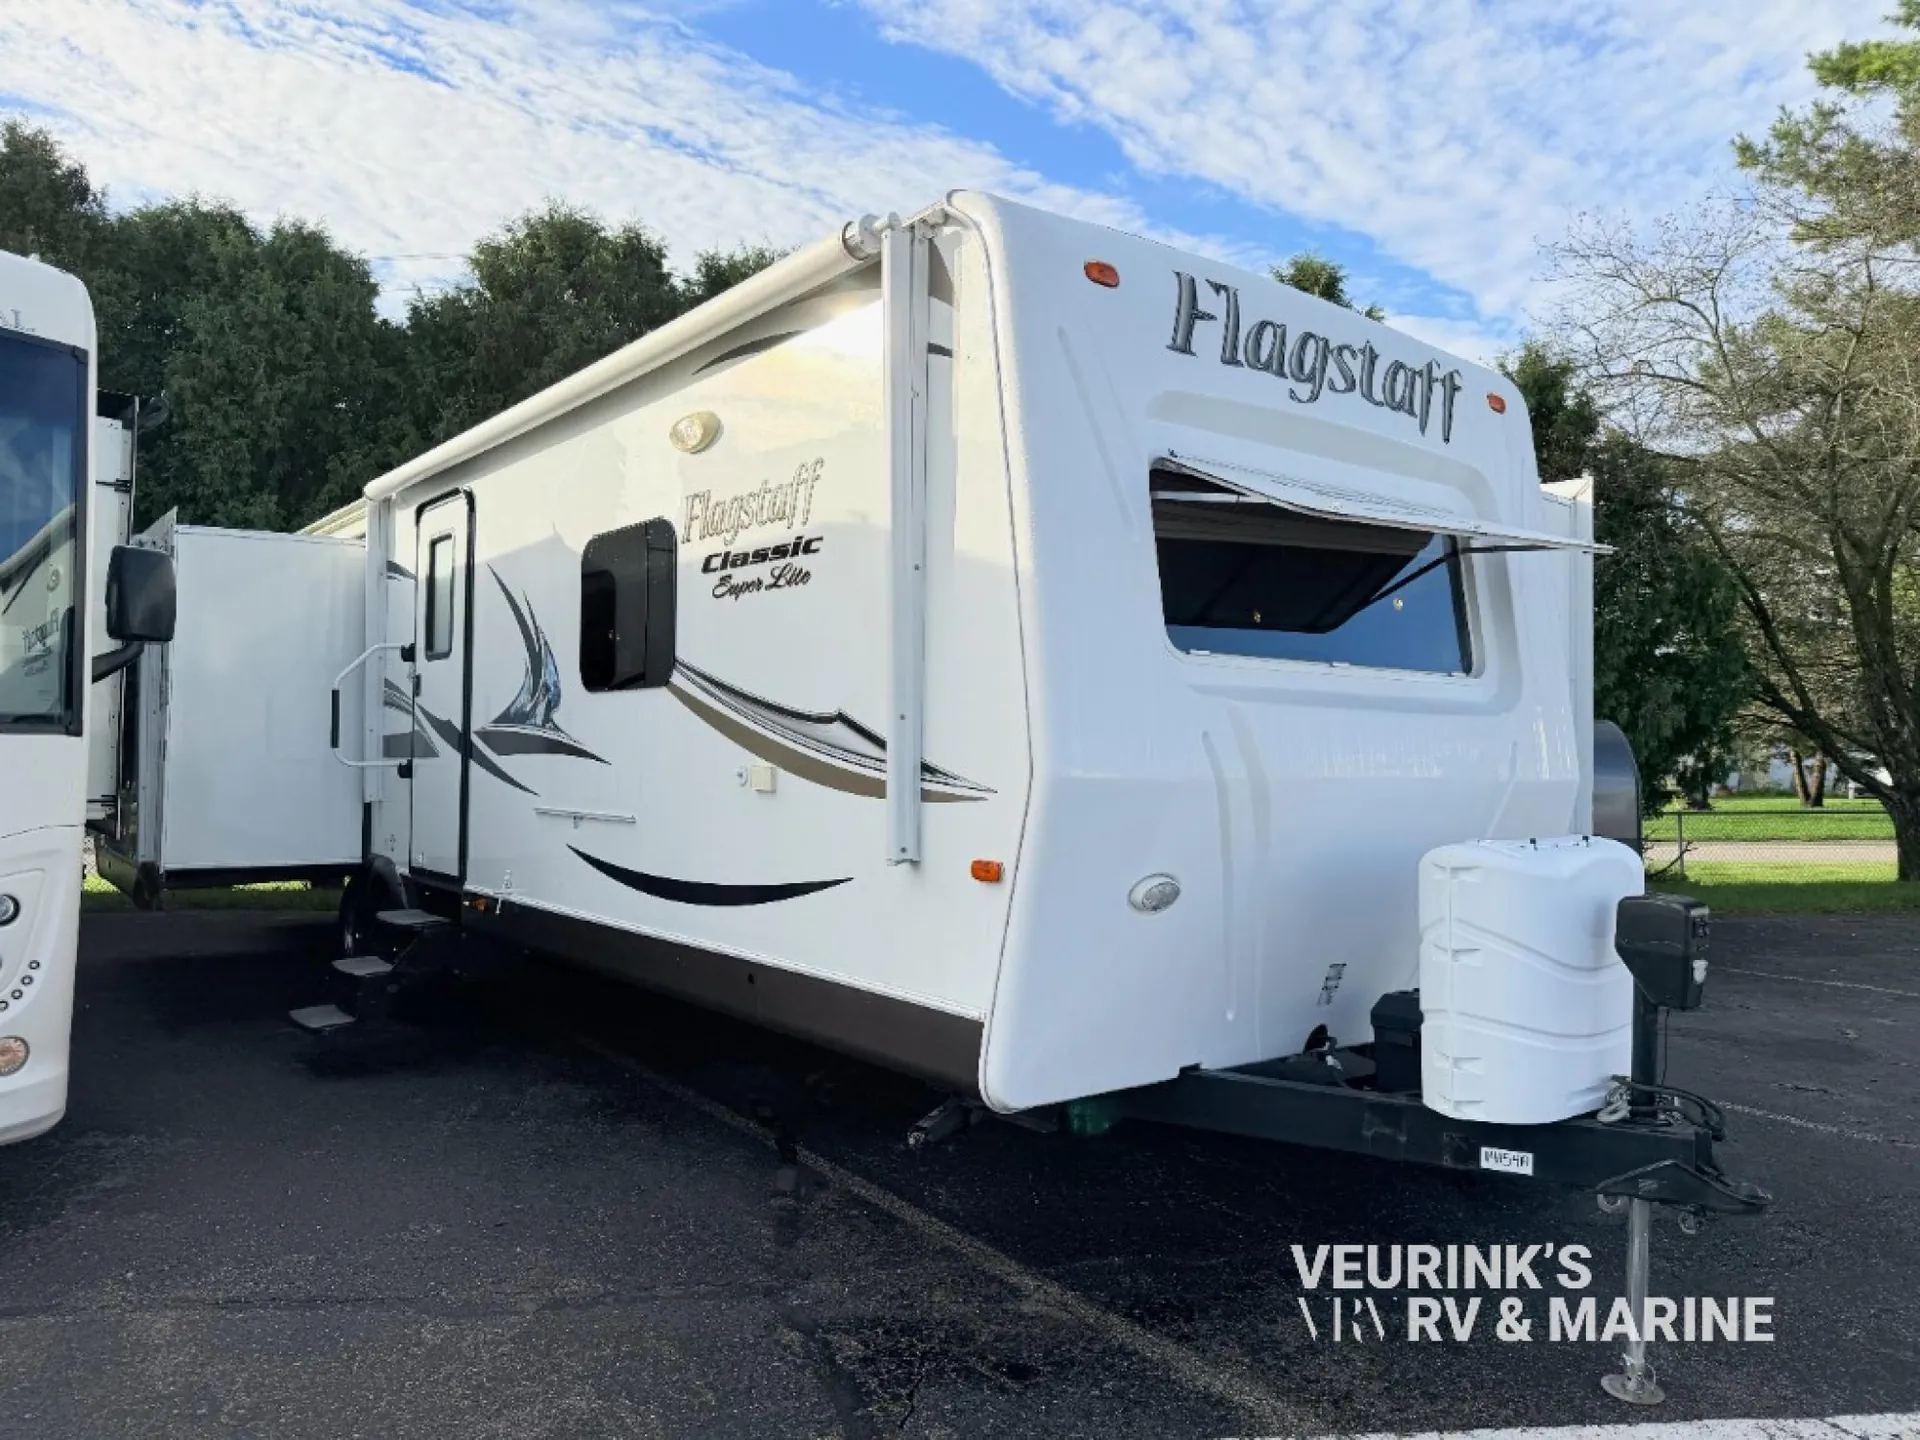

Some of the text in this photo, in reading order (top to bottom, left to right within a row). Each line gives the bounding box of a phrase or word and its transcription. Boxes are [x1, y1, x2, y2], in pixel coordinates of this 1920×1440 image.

[1166, 269, 1463, 445] Flagstaff
[681, 457, 825, 546] Flagstaff
[702, 535, 824, 574] Classic
[712, 562, 812, 601] Super Lite
